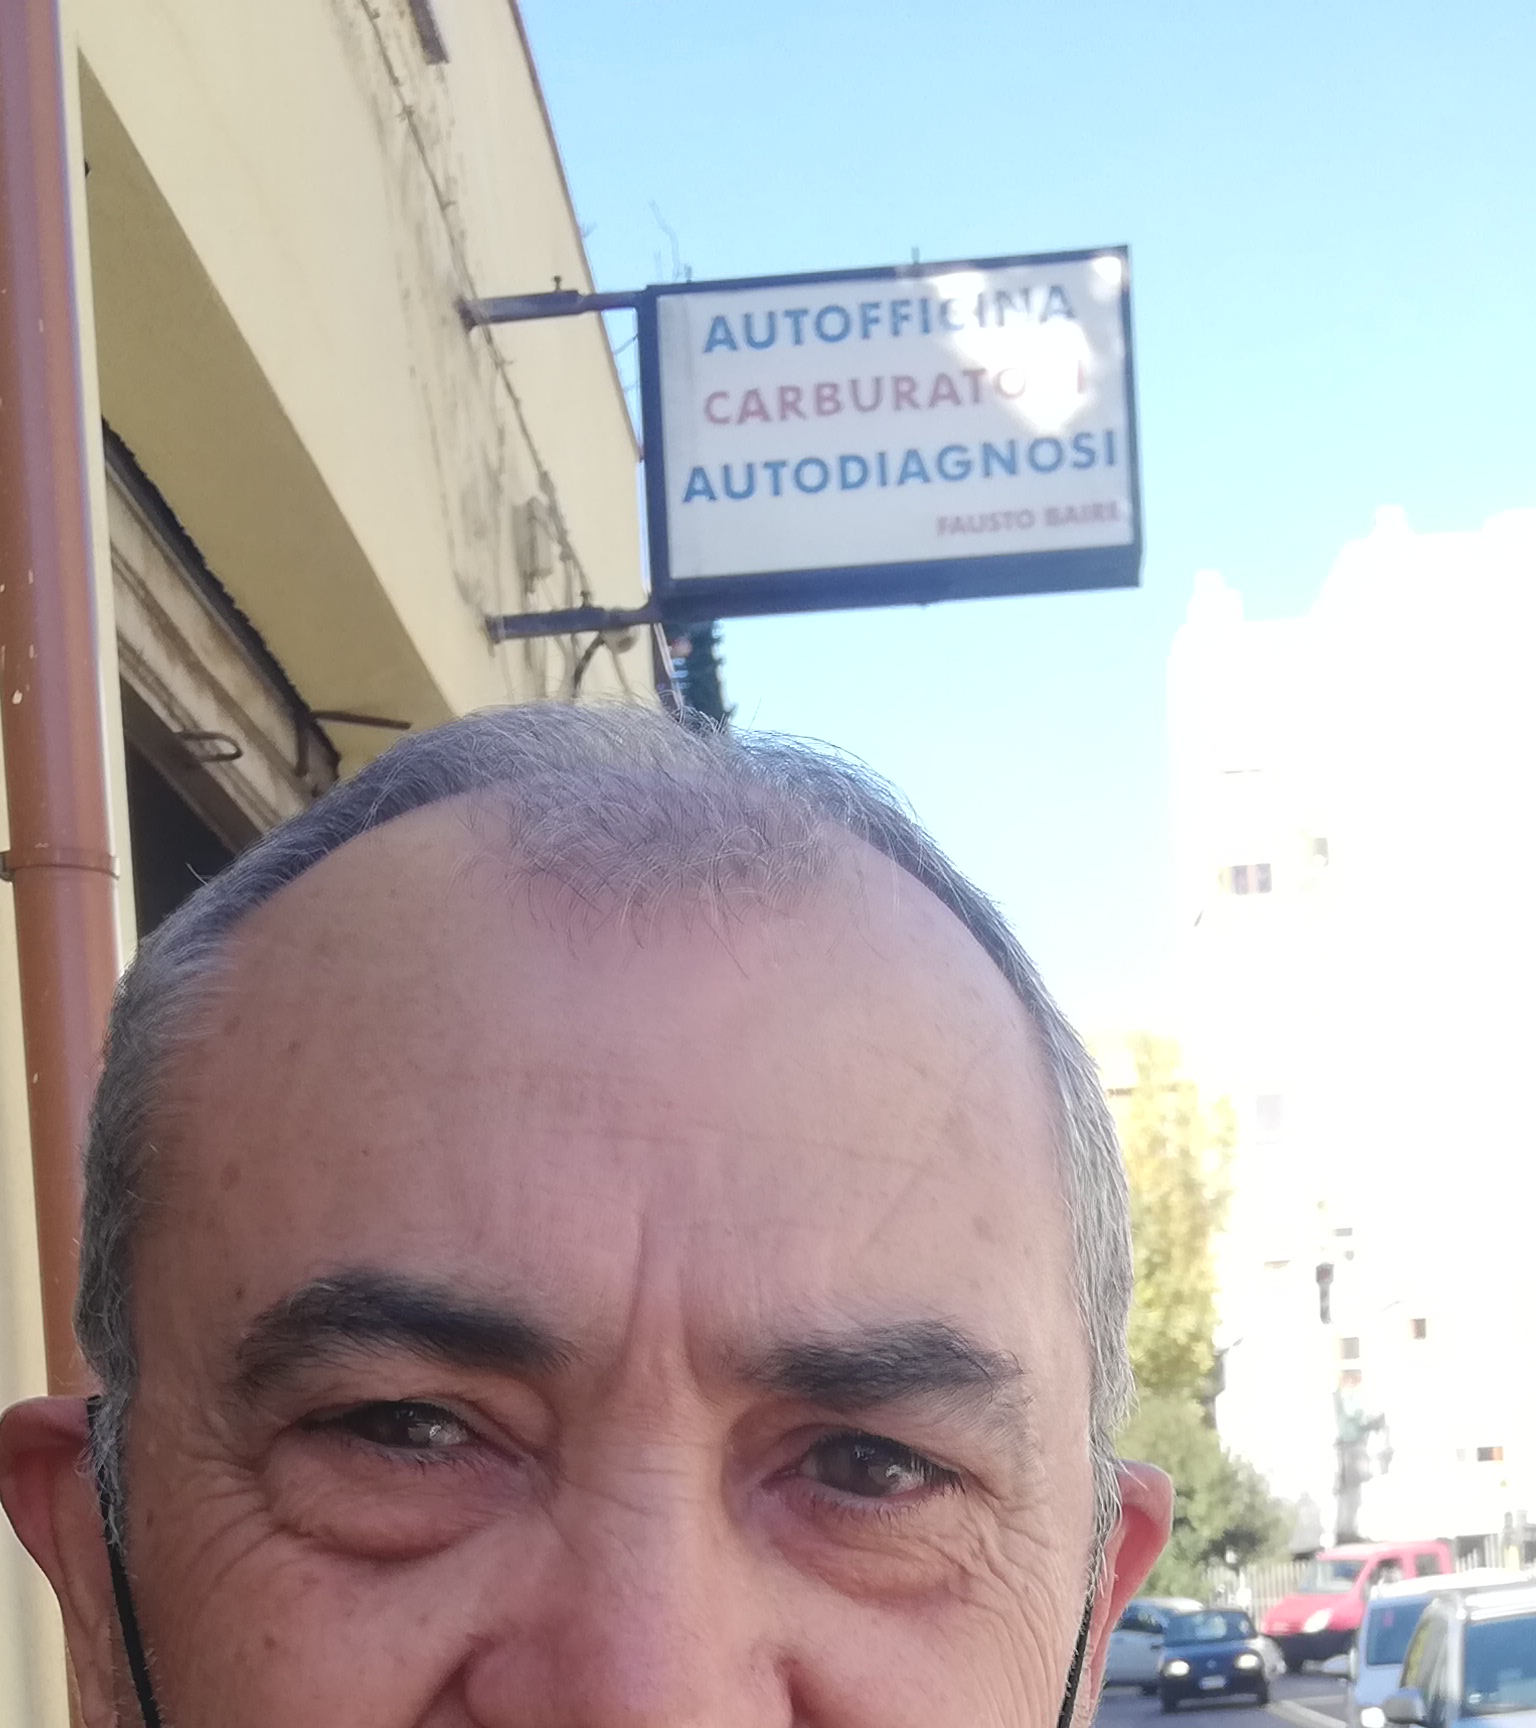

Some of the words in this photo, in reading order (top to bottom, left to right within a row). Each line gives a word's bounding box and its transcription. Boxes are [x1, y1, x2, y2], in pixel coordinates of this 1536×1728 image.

[702, 284, 1077, 353] AUTOFFICINA
[703, 359, 1088, 426] CARBURATOI
[682, 429, 1117, 504] AUTODIAGNOSI
[936, 508, 1036, 538] FAUSTO
